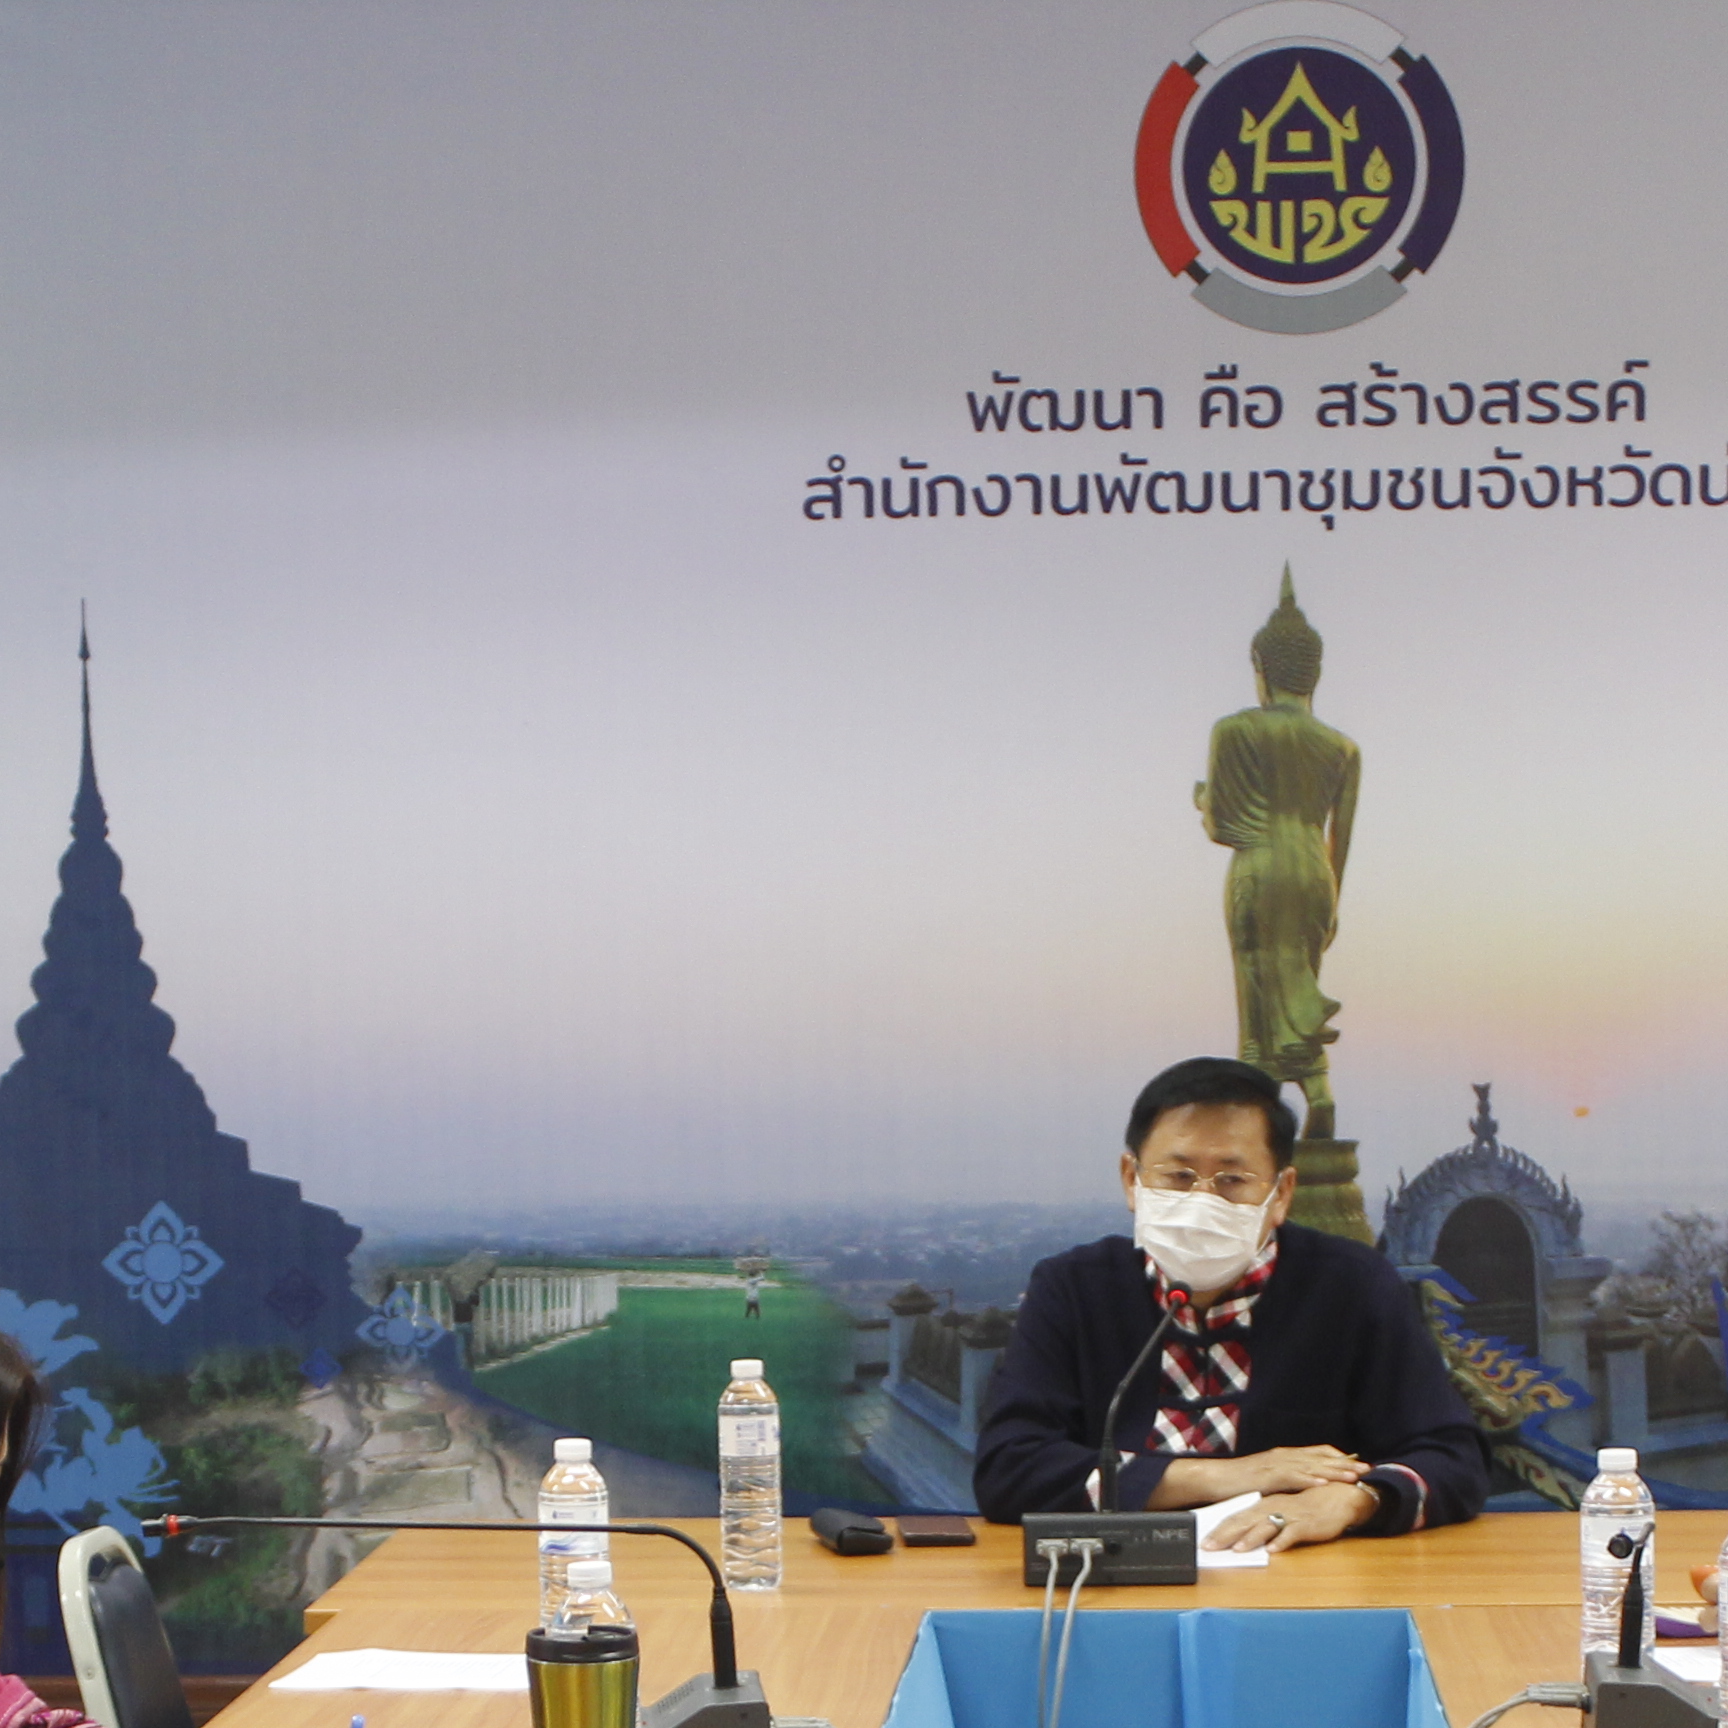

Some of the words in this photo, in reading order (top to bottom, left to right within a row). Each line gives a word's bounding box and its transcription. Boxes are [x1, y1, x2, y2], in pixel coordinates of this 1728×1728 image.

[966, 370, 1164, 432] พัฒนา
[1199, 363, 1284, 429] คือ
[1315, 359, 1651, 428] สร้างสรรค์
